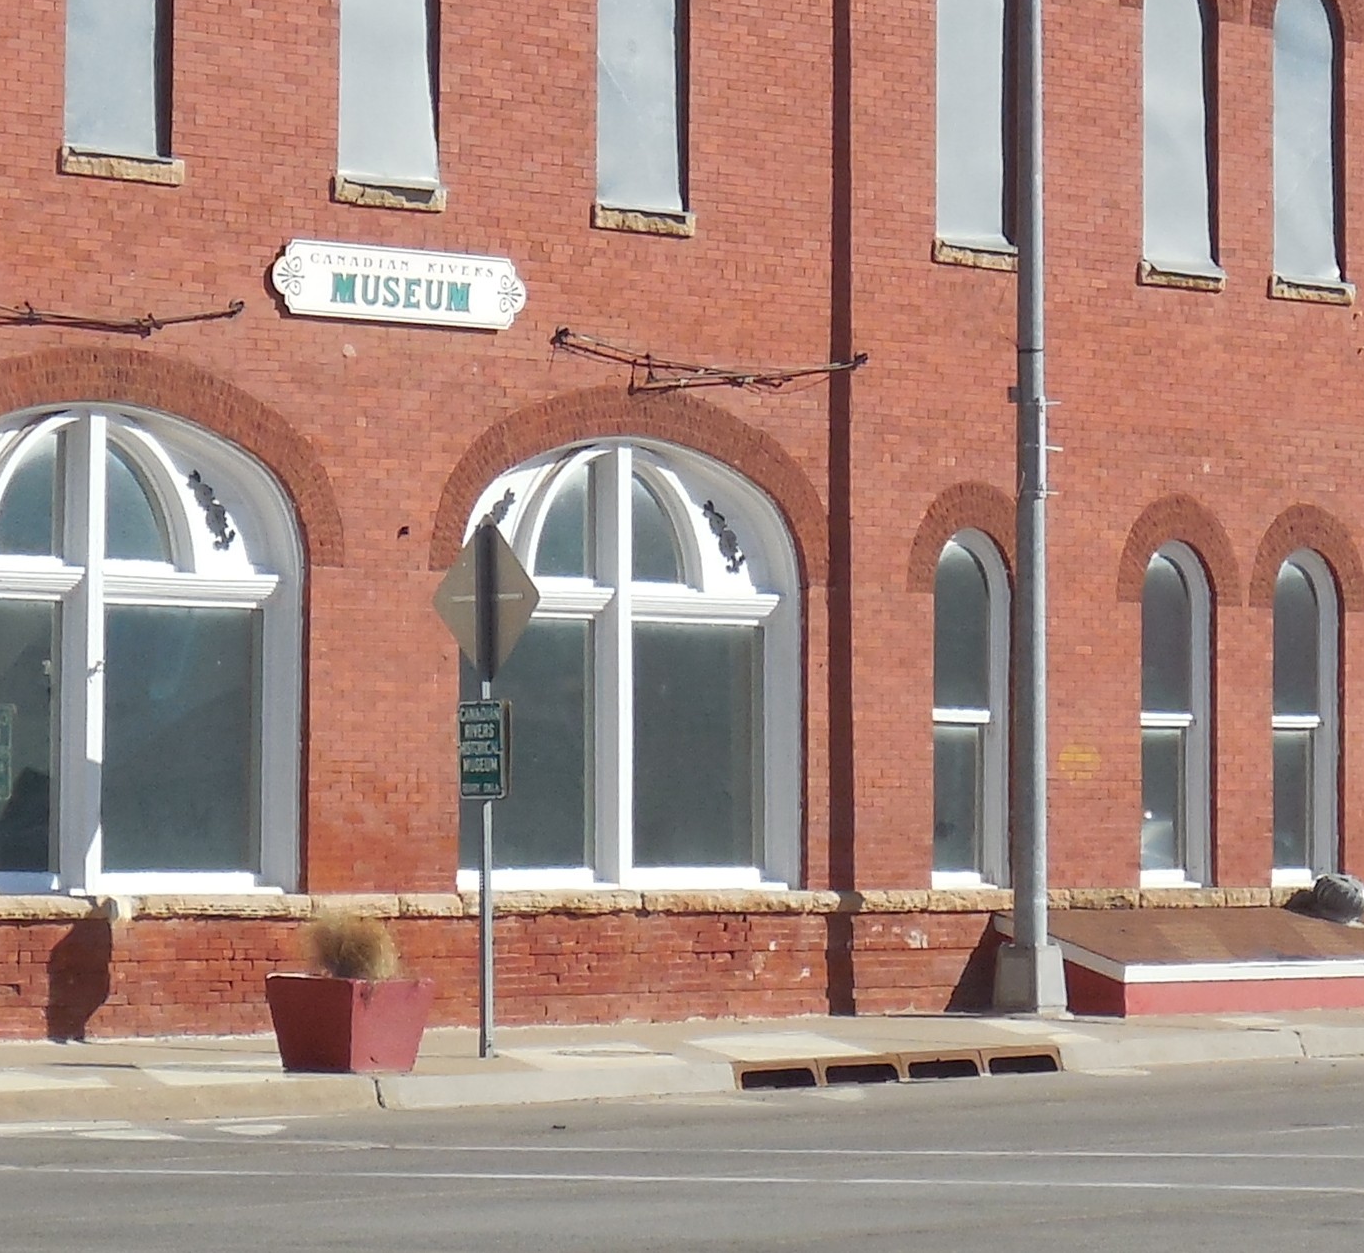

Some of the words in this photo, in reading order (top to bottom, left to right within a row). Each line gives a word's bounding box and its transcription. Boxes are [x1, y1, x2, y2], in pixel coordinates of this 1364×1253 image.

[309, 251, 411, 272] CANADIAN
[427, 262, 495, 279] RIVERS
[329, 271, 472, 314] MUSEUM
[463, 723, 495, 739] RIVERS
[462, 757, 498, 773] MUSEUM
